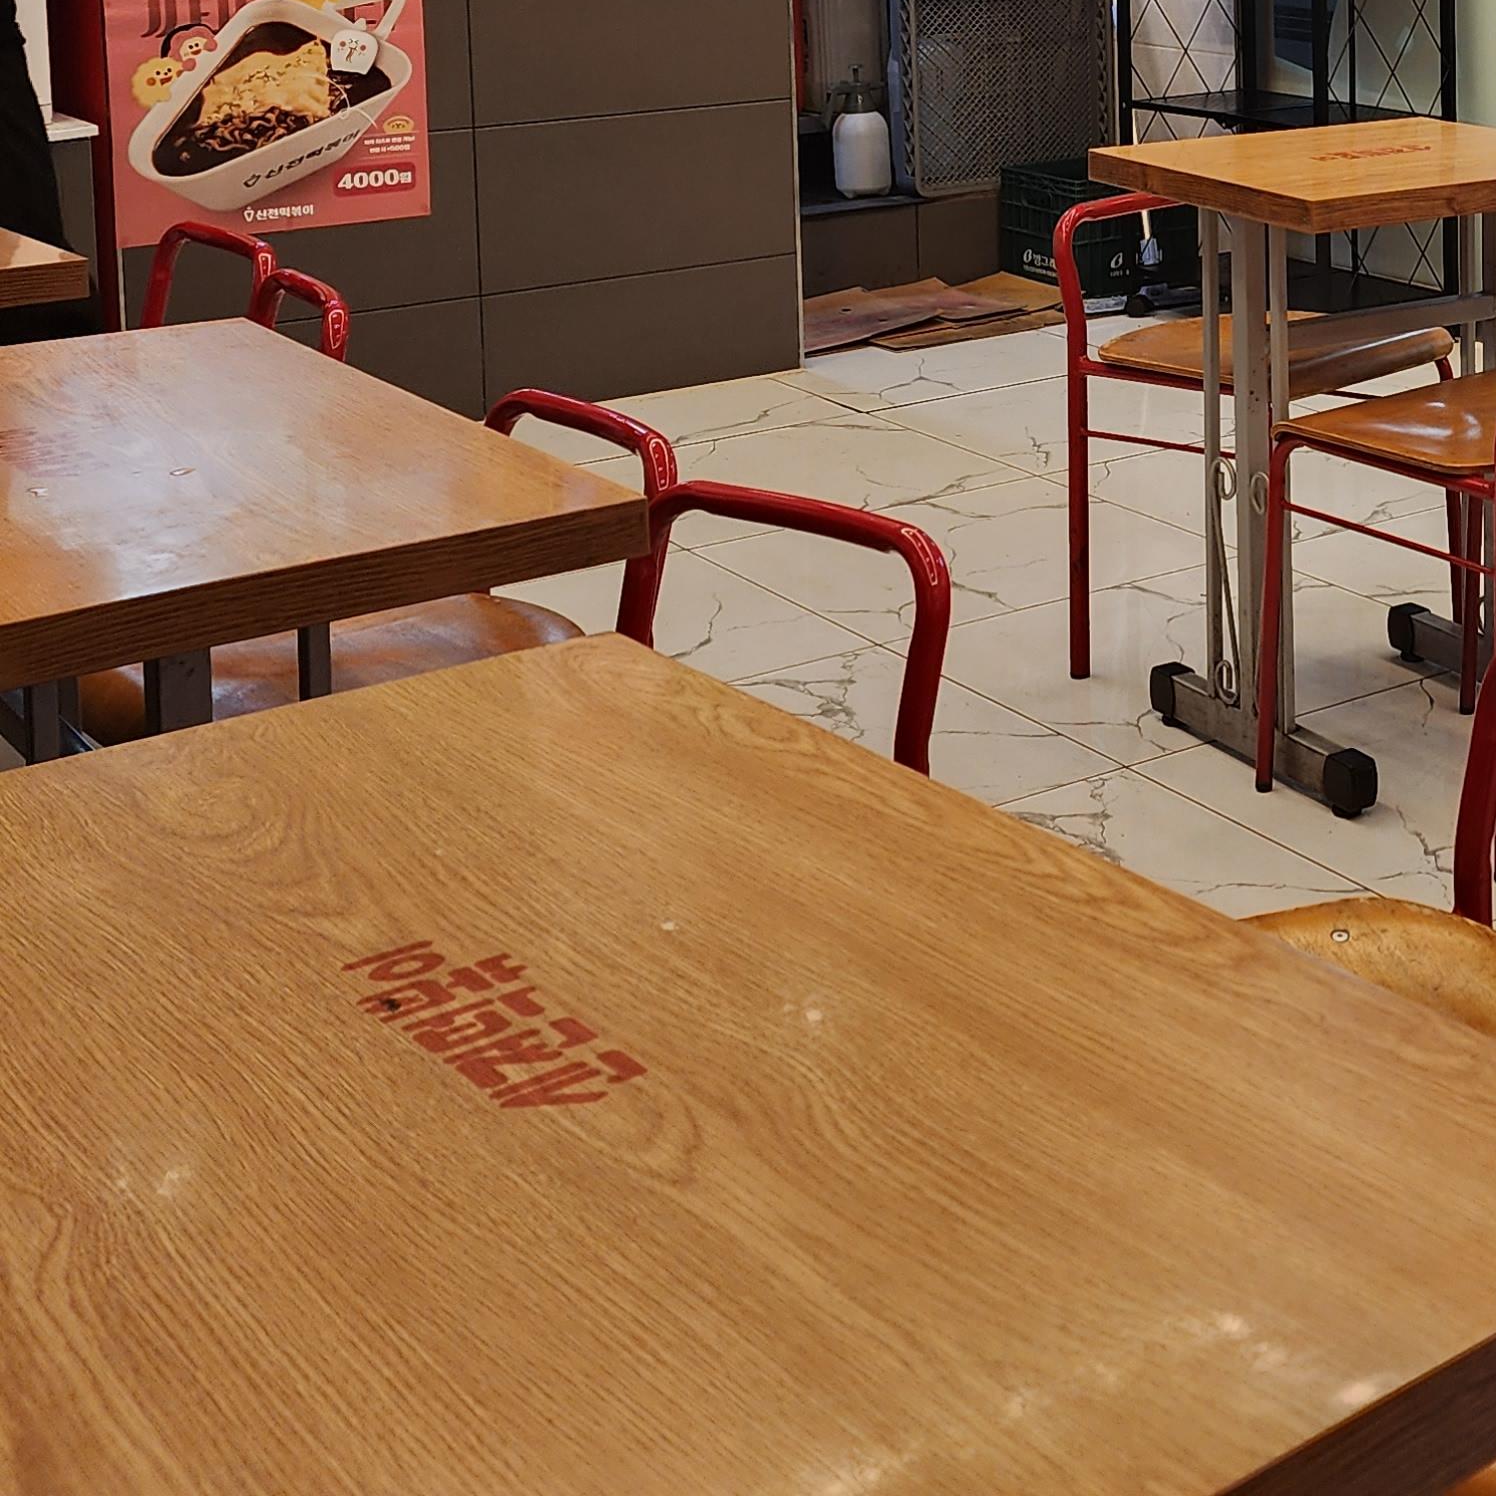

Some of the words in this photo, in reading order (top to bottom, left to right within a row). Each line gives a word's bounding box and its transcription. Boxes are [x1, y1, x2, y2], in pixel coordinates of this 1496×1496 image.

[265, 129, 361, 179] 신전떡볶이
[337, 169, 412, 190] 4000원
[256, 204, 314, 221] 신전떡볶이
[340, 940, 648, 1109] 신전떡볶이
